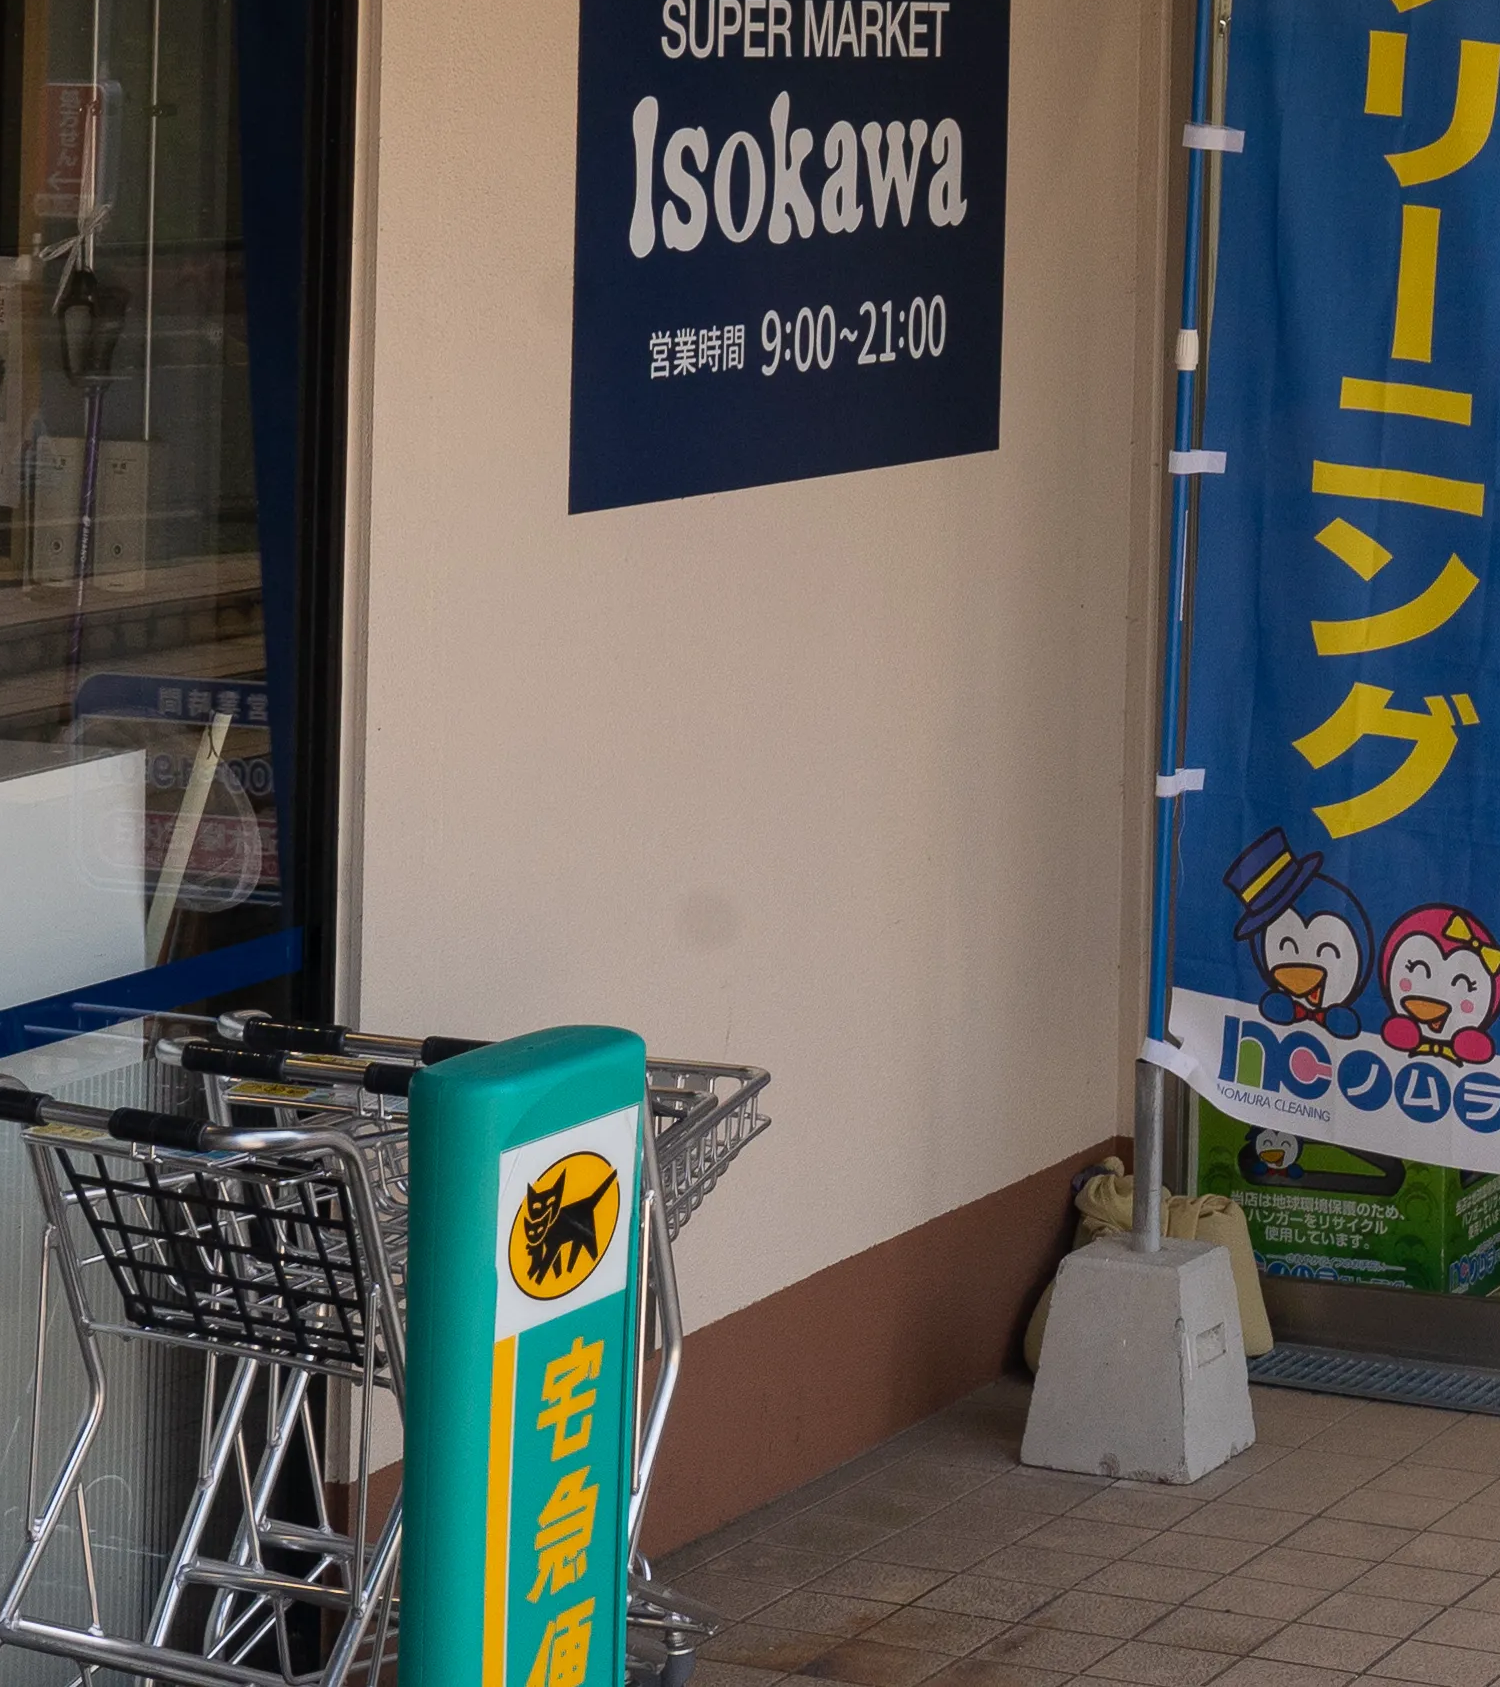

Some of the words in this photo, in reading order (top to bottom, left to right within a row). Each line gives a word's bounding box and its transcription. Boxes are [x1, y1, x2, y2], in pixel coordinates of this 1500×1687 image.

[803, 0, 950, 58] MARKET
[629, 91, 968, 258] Isokawa
[649, 323, 745, 380] 営業時間
[1216, 1083, 1271, 1108] NOMURA
[1274, 1099, 1331, 1123] CLEANING
[1230, 1190, 1407, 1221] 当店は地球環境保護のため、
[1248, 1209, 1388, 1235] ハンガーをリサイクル
[1265, 1225, 1371, 1250] 使用しています。
